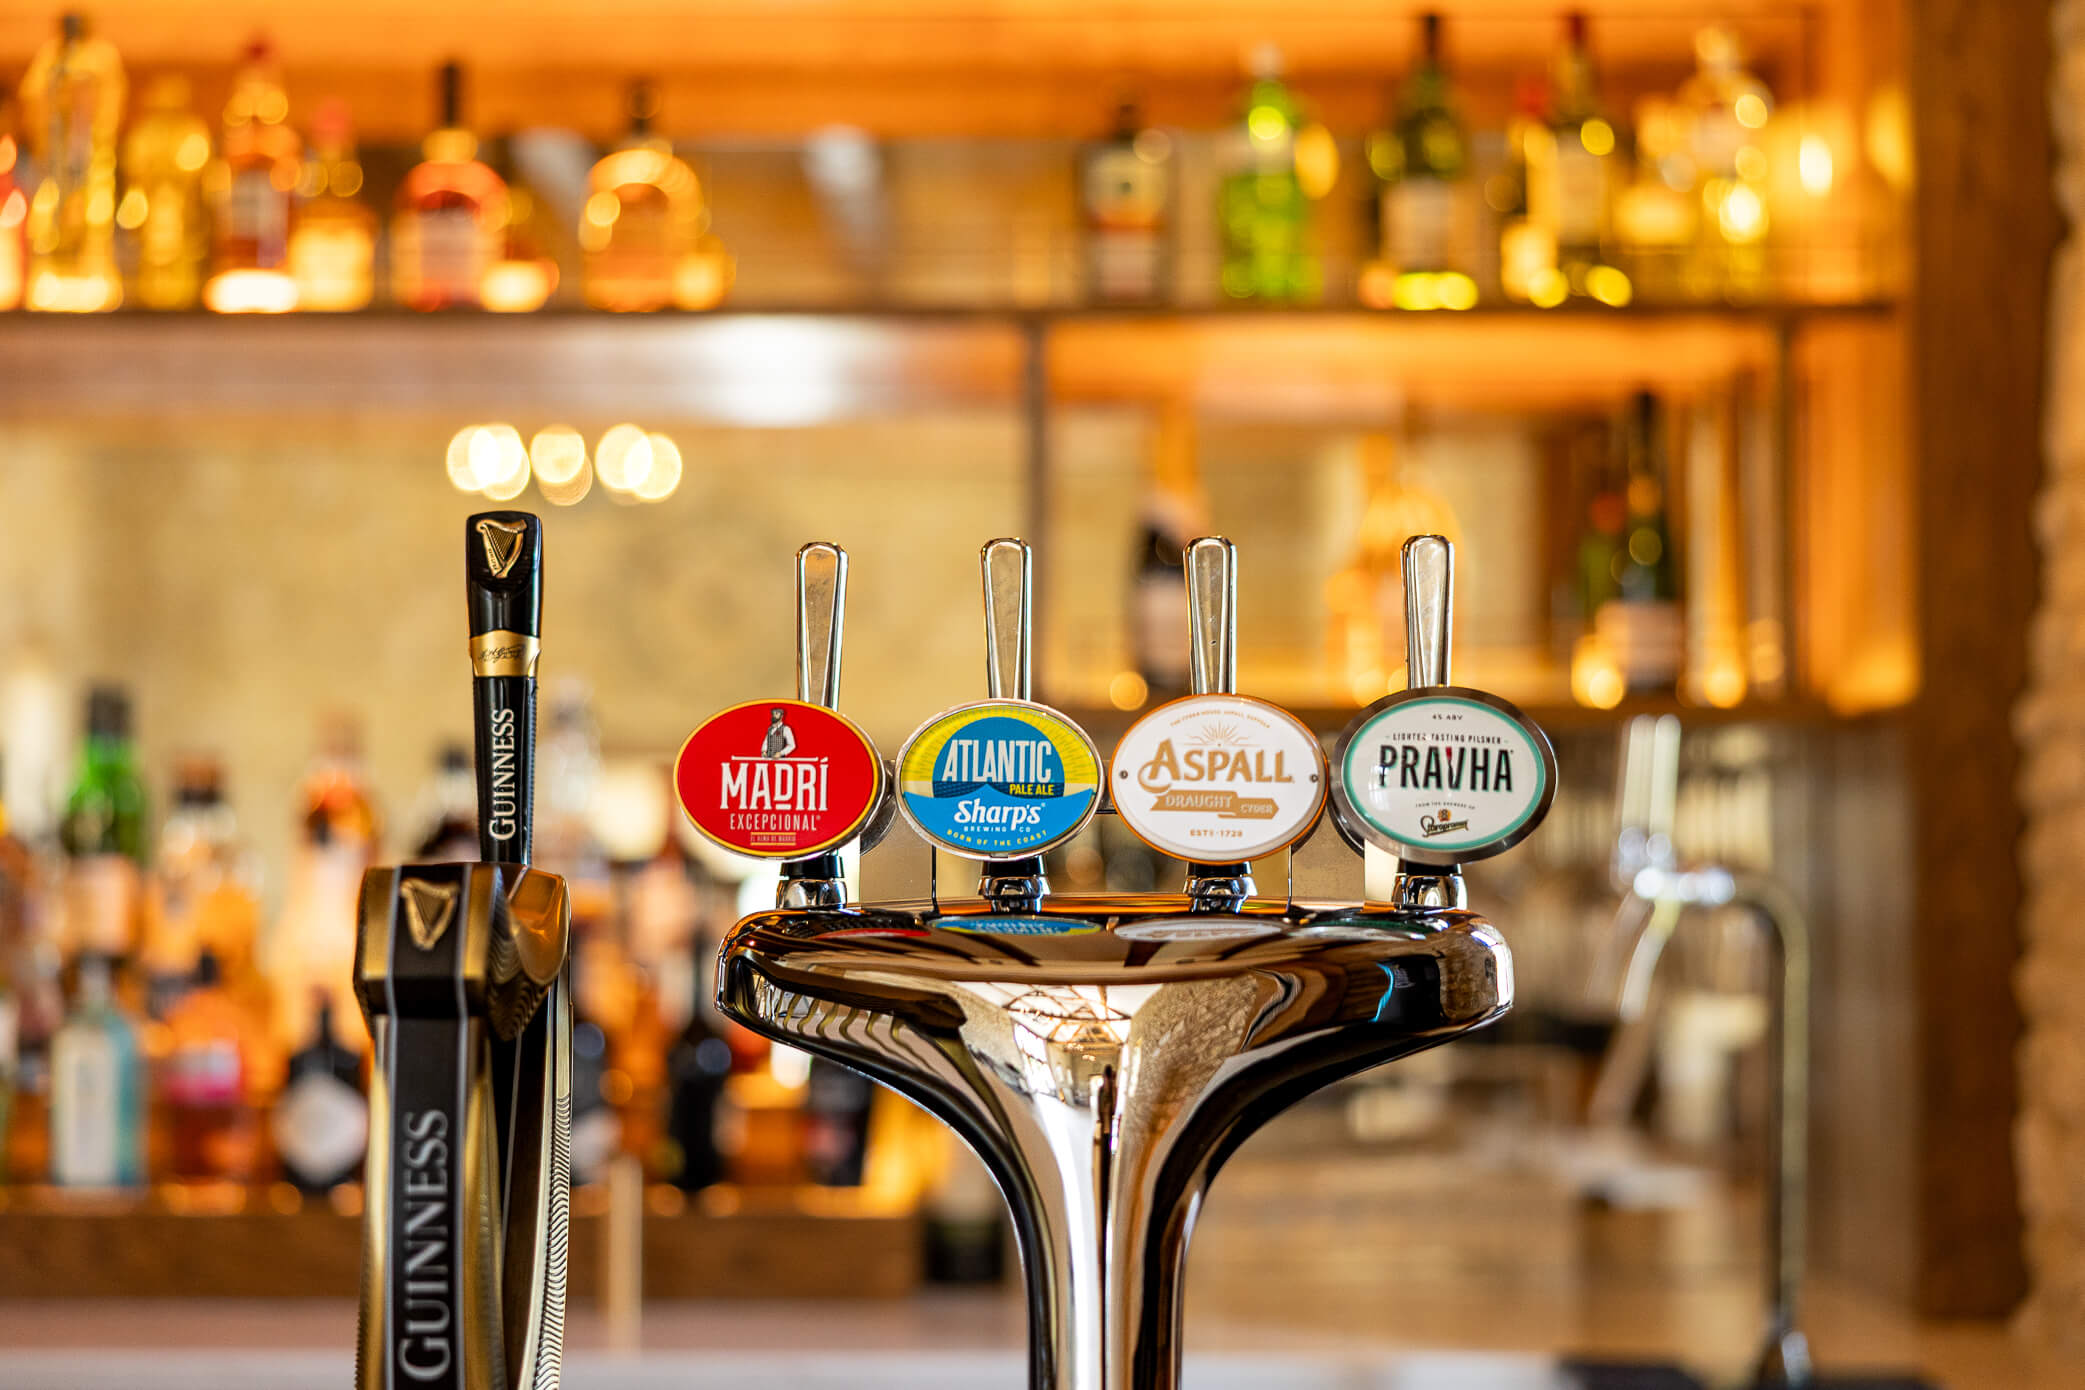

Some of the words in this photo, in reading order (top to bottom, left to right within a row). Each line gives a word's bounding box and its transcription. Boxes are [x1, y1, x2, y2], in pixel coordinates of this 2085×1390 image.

[1431, 733, 1465, 743] TASTING
[1468, 735, 1501, 744] PILSNER
[488, 707, 516, 841] GUINNESS
[942, 739, 1052, 783] ATLANTIC
[1137, 738, 1293, 793] ASPALL
[1379, 744, 1513, 792] PRAVHA
[720, 756, 829, 811] MADRÍ
[1009, 783, 1033, 795] PALE
[1035, 784, 1055, 796] ALE
[954, 798, 1042, 831] Sharp's
[1165, 794, 1233, 809] DRAUGHT
[1240, 804, 1273, 814] CYDER
[730, 813, 817, 831] EXCEPCIONAL
[947, 829, 972, 842] BORN
[1016, 829, 1047, 845] COAST
[398, 1108, 451, 1382] GUINNESS
